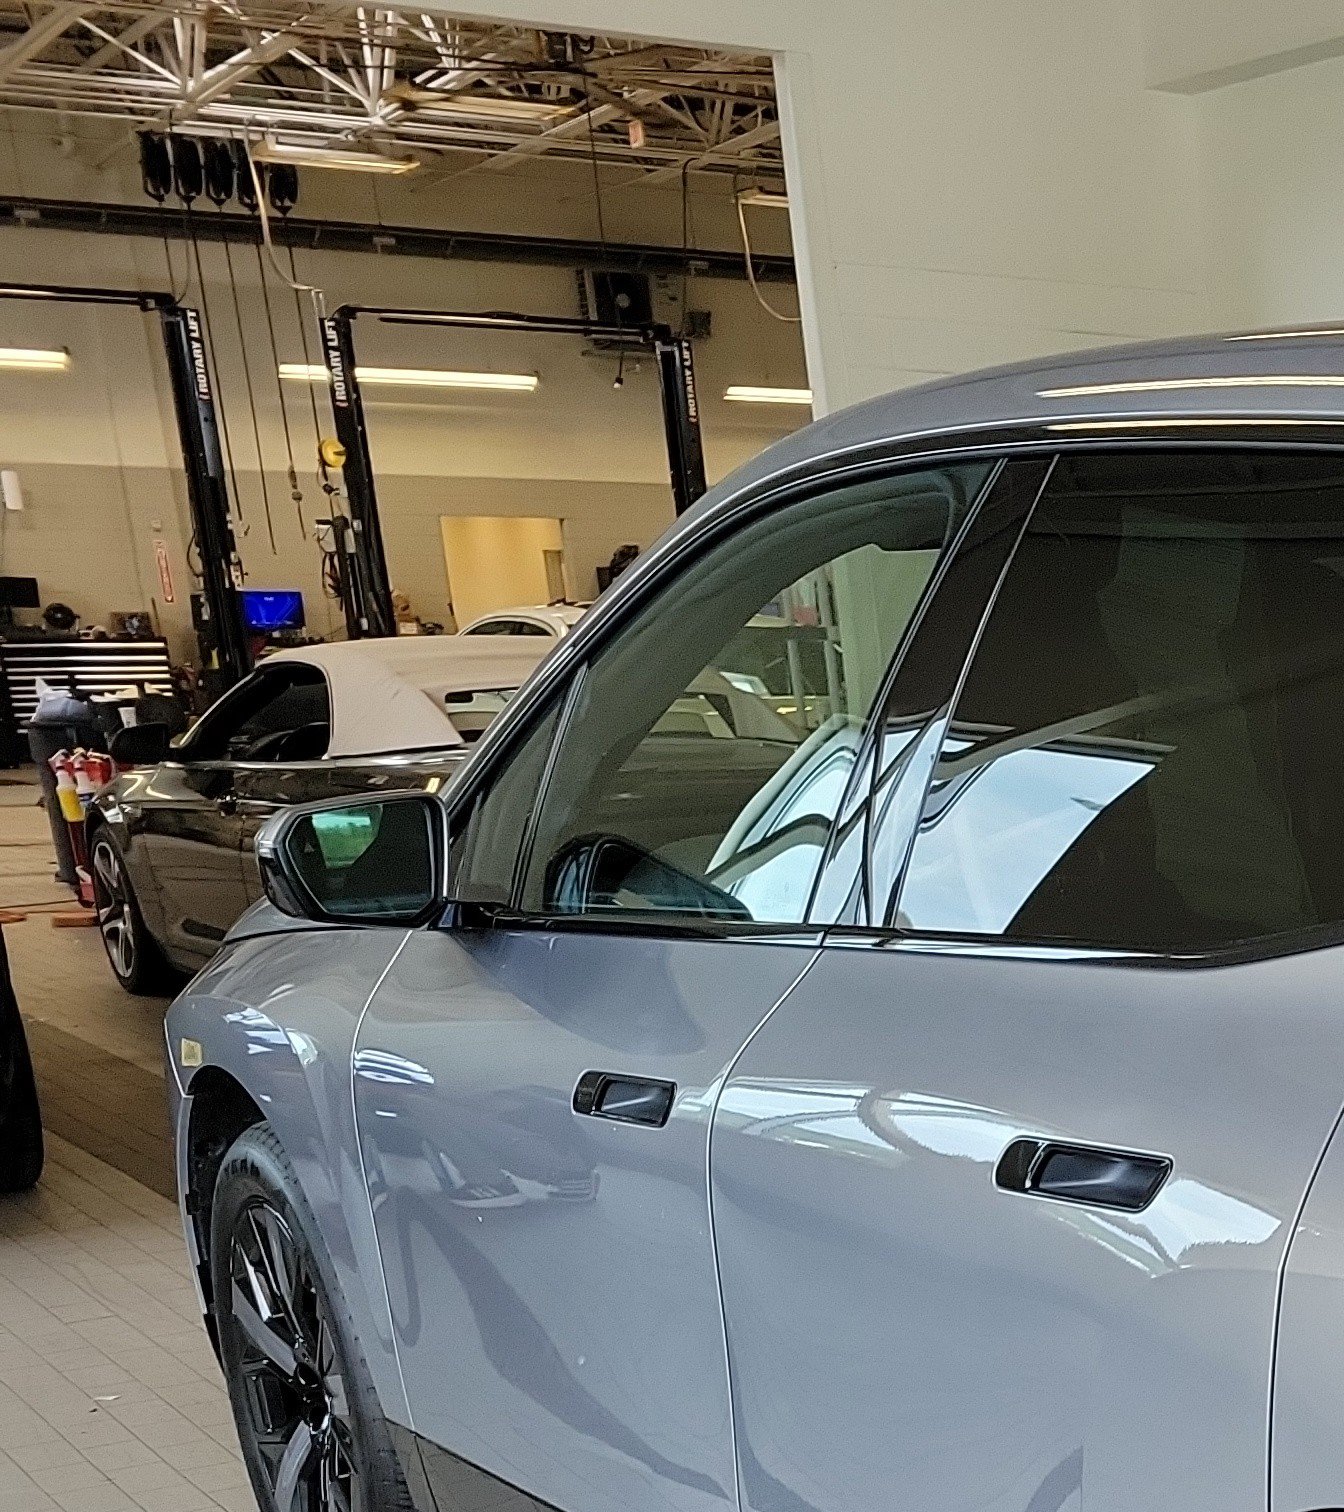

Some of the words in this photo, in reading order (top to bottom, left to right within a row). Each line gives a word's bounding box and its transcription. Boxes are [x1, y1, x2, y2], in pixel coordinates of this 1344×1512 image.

[186, 309, 200, 338] LIFT
[324, 319, 339, 347] LIFT
[191, 340, 209, 393] ROTARY
[328, 350, 347, 401] ROTARY
